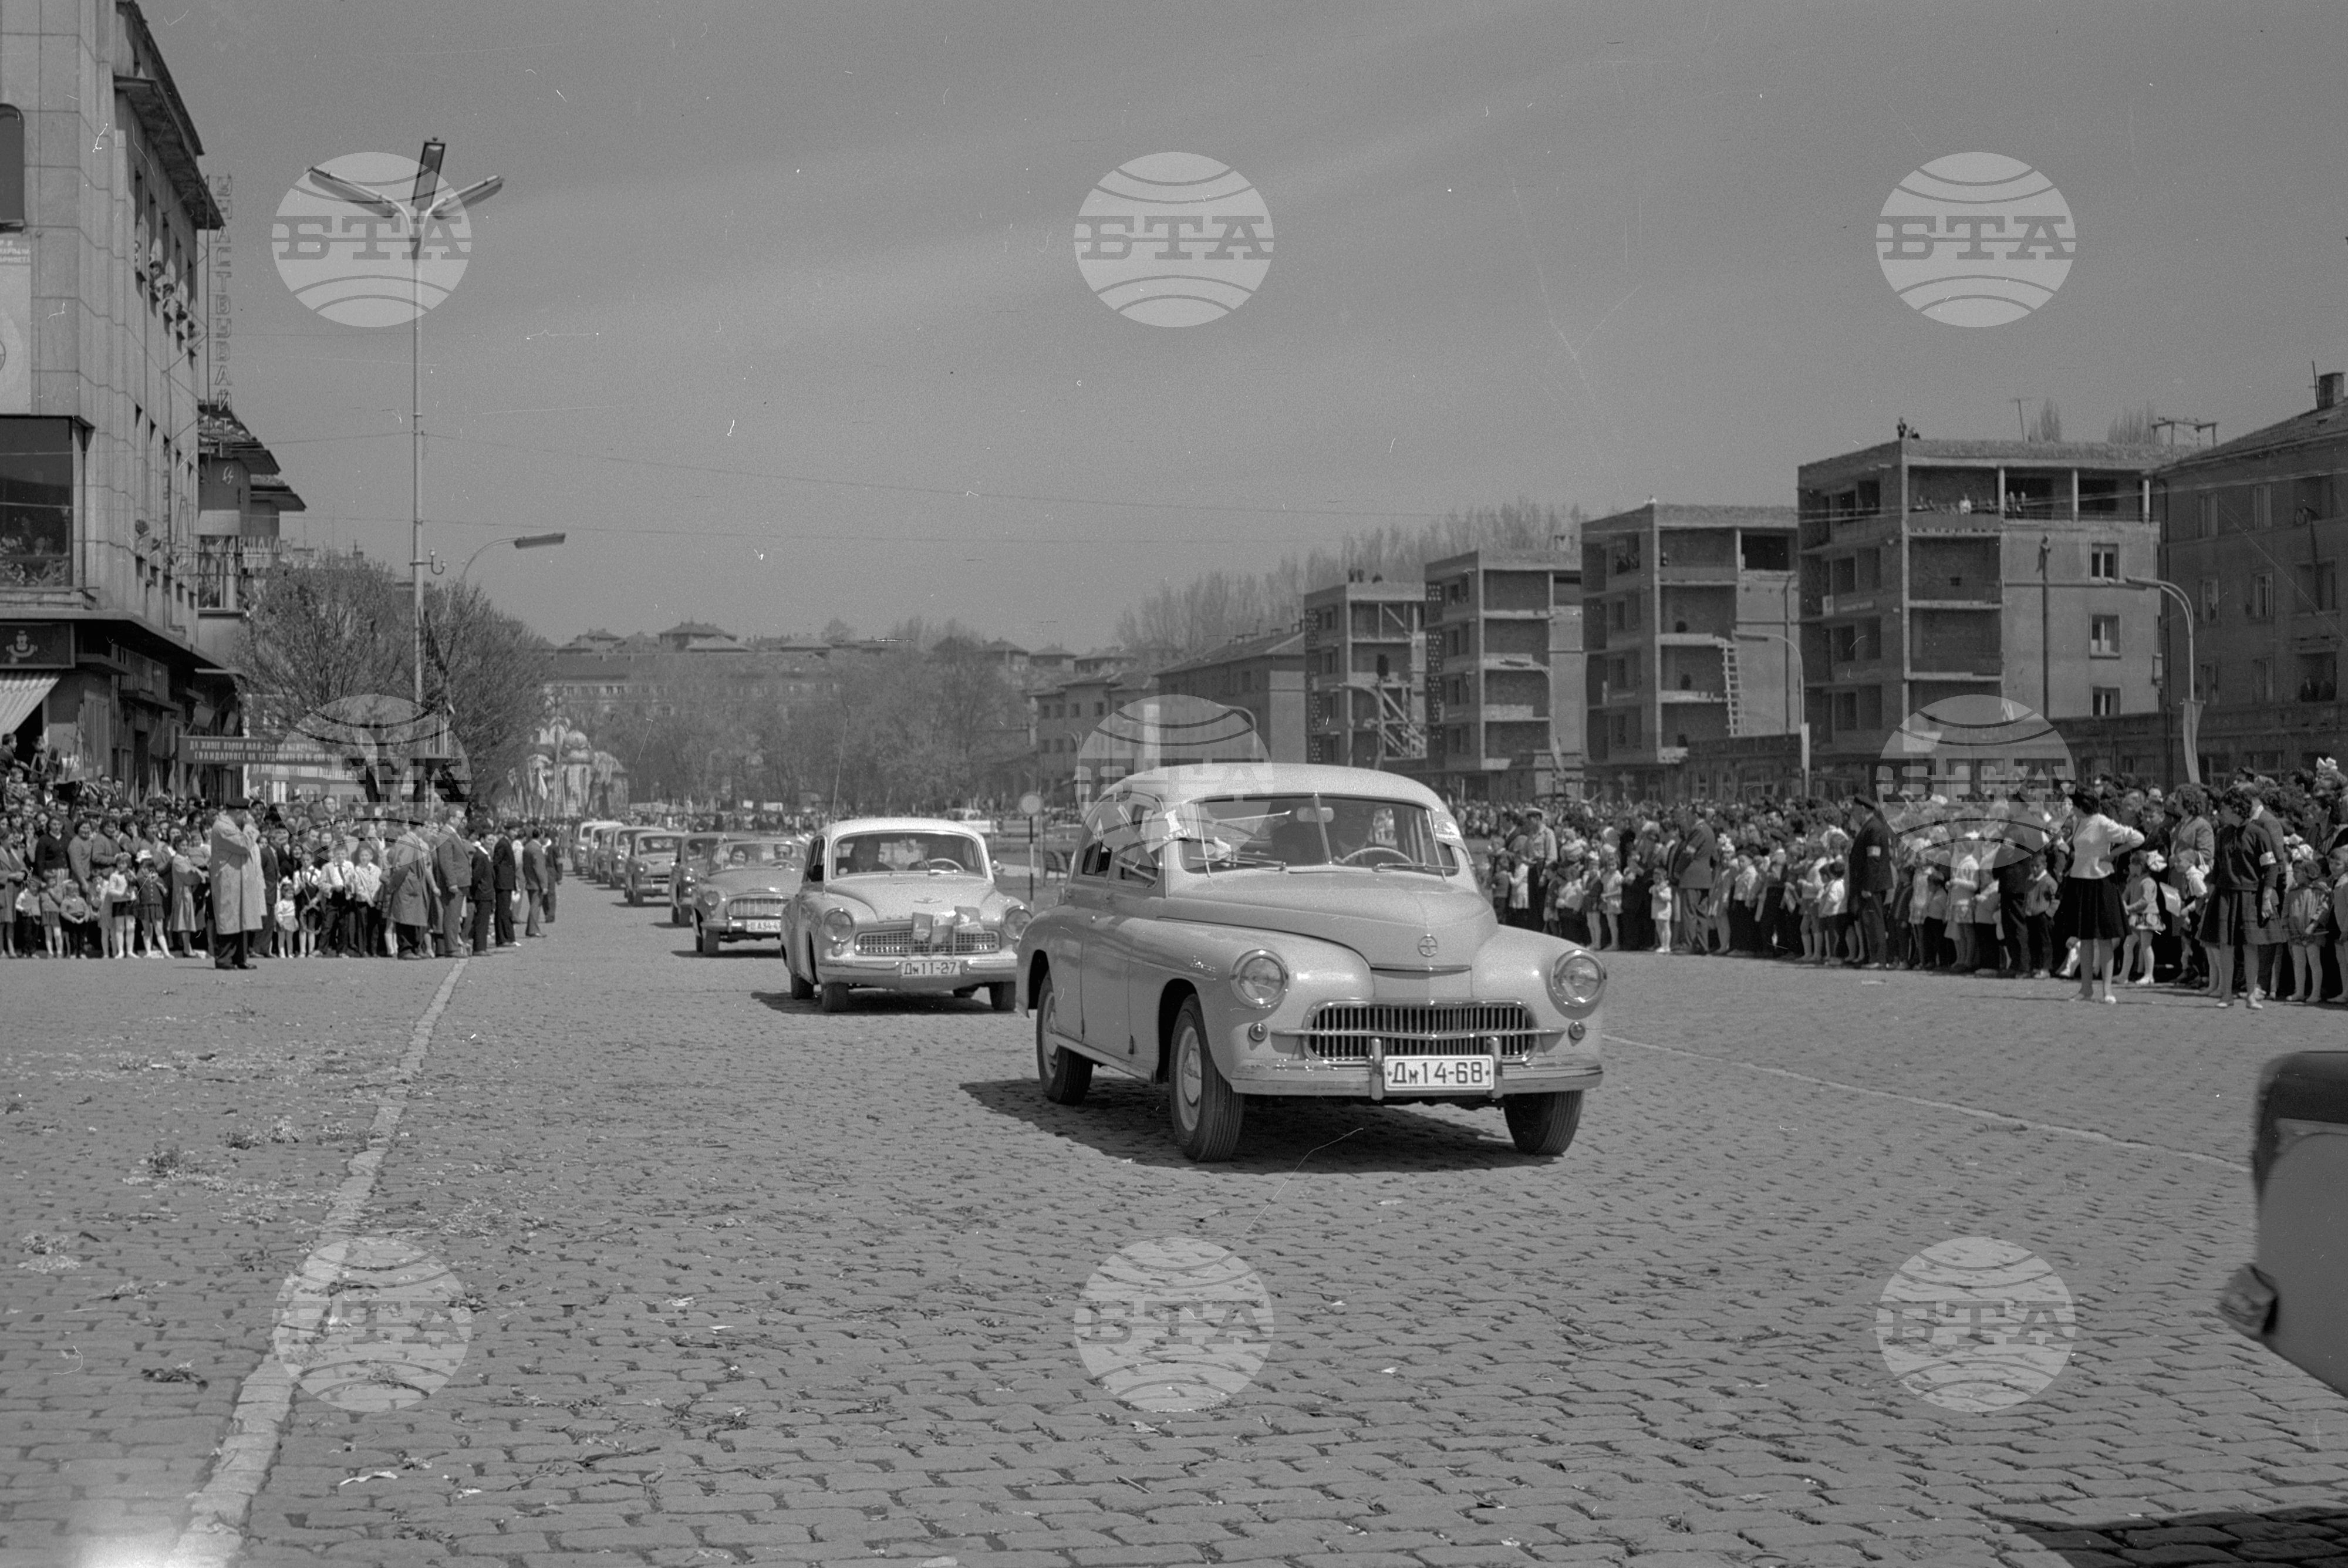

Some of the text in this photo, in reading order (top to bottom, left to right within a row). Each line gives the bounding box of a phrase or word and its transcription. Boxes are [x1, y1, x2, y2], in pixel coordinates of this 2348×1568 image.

[922, 962, 957, 975] 11-27
[1392, 1061, 1482, 1084] Дм 14-68
